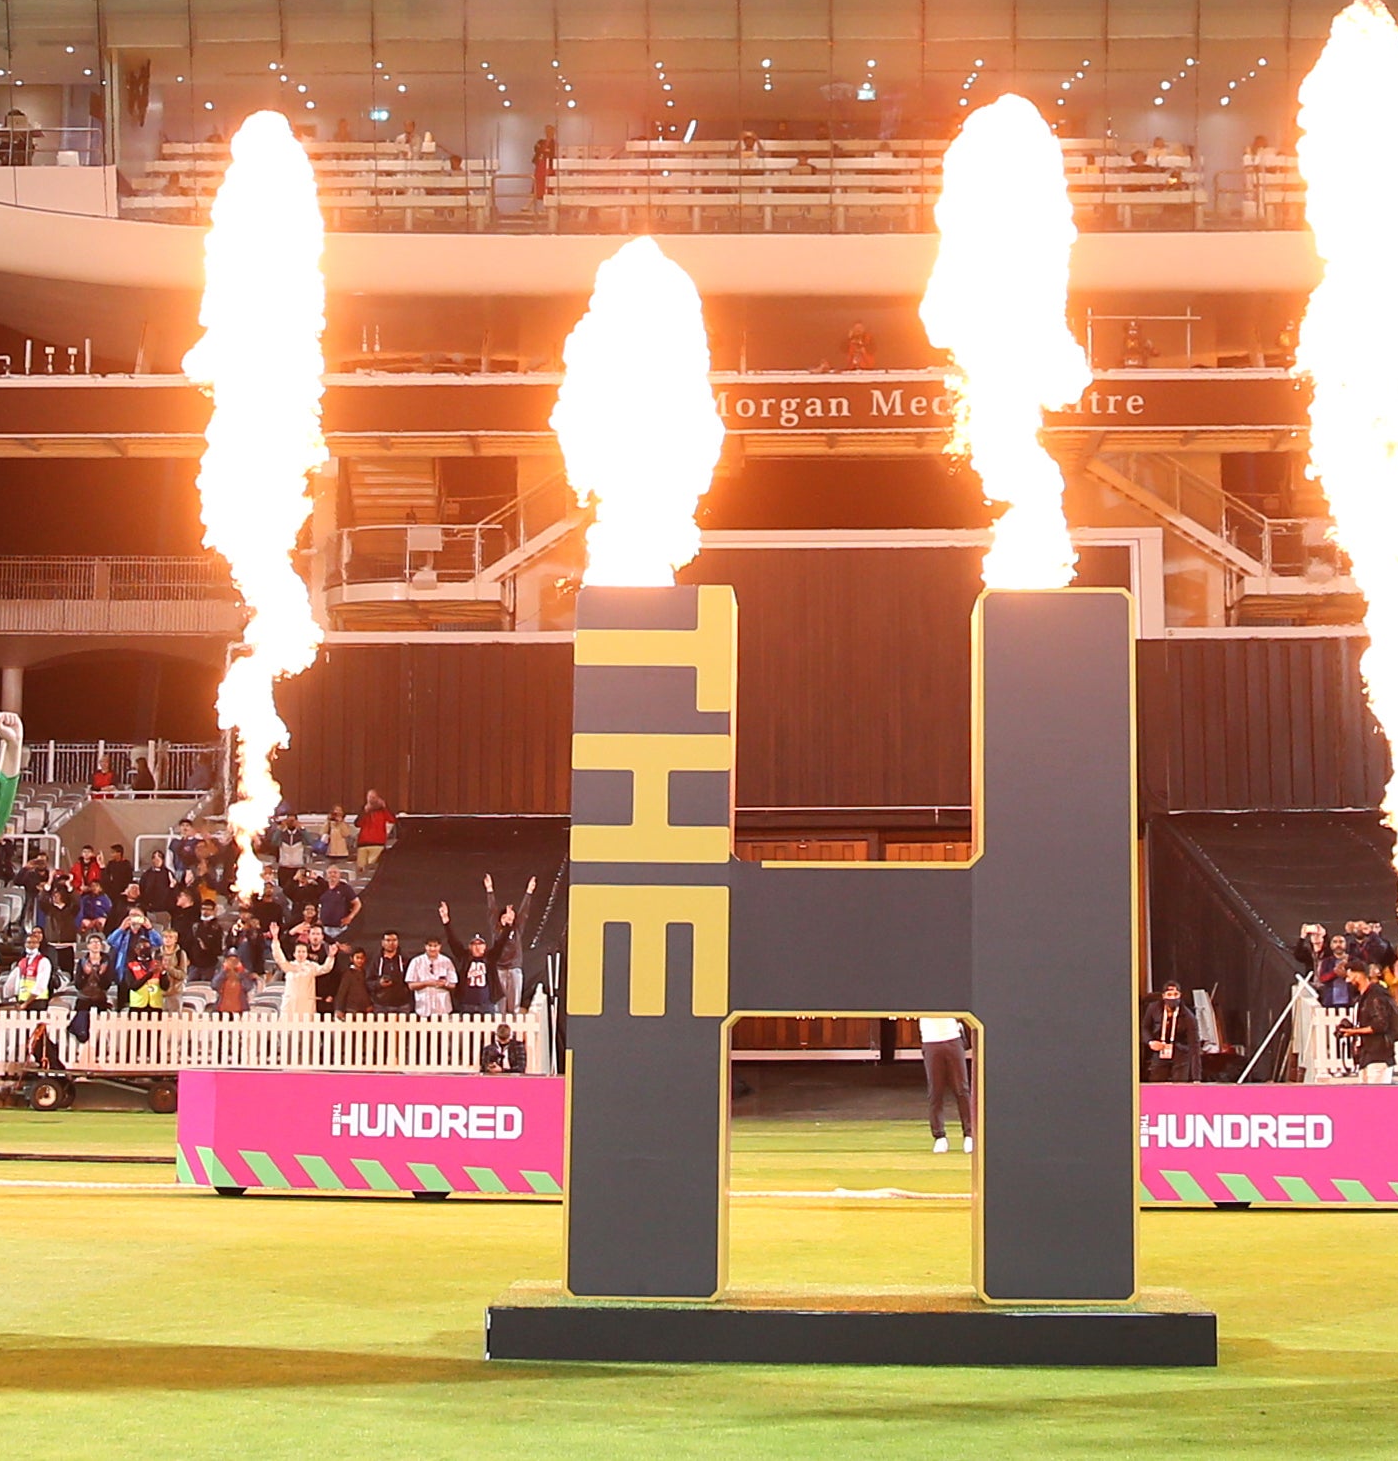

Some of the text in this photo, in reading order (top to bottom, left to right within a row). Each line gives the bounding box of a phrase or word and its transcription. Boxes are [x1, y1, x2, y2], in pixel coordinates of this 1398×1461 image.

[870, 389, 953, 417] Med
[1075, 393, 1145, 415] tre
[566, 585, 733, 1017] THE
[332, 1103, 523, 1139] HUNDRED
[1140, 1114, 1333, 1148] HUNDRED
